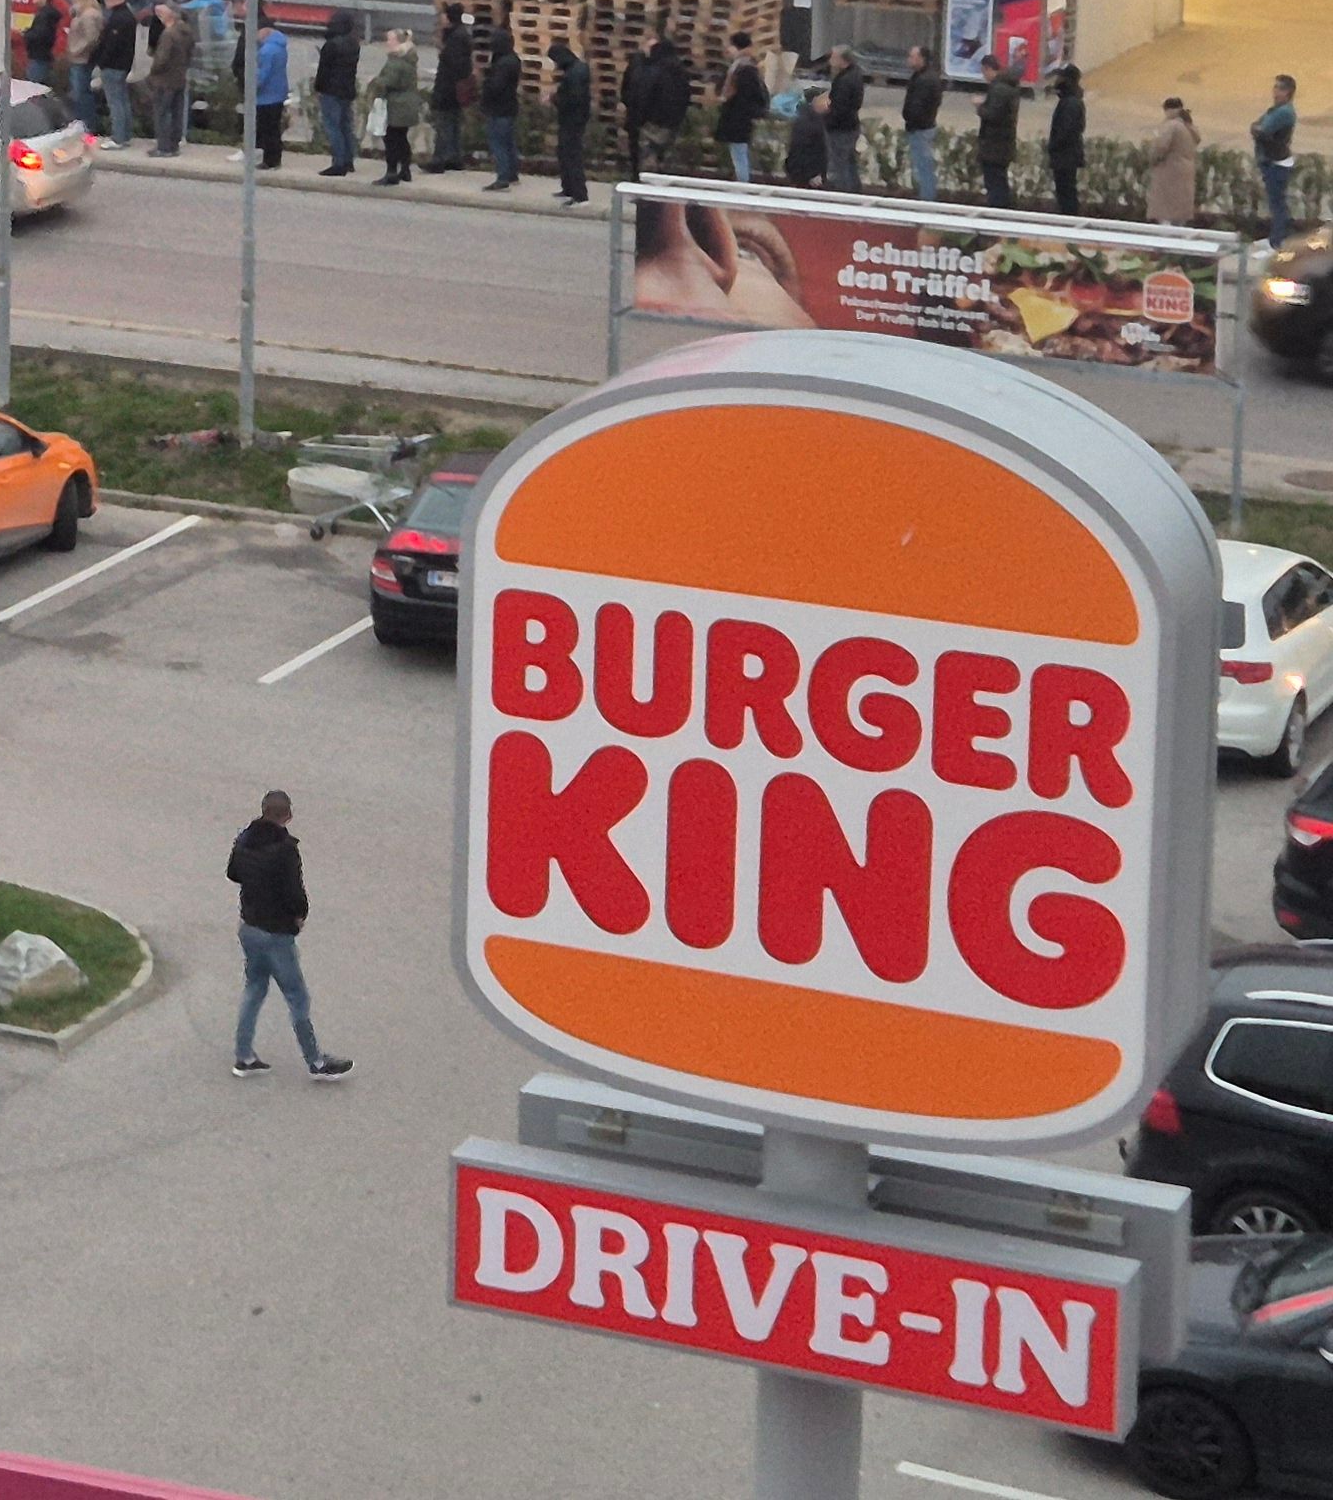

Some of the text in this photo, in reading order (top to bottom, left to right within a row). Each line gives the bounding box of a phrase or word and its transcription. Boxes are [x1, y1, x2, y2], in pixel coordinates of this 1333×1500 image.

[837, 263, 1000, 304] den Trüffel.
[852, 239, 984, 275] Schnüffel
[1146, 296, 1190, 313] KING
[491, 587, 1134, 811] BURGER
[485, 729, 1127, 1011] KING
[473, 1185, 1098, 1410] DRIVE-IN
